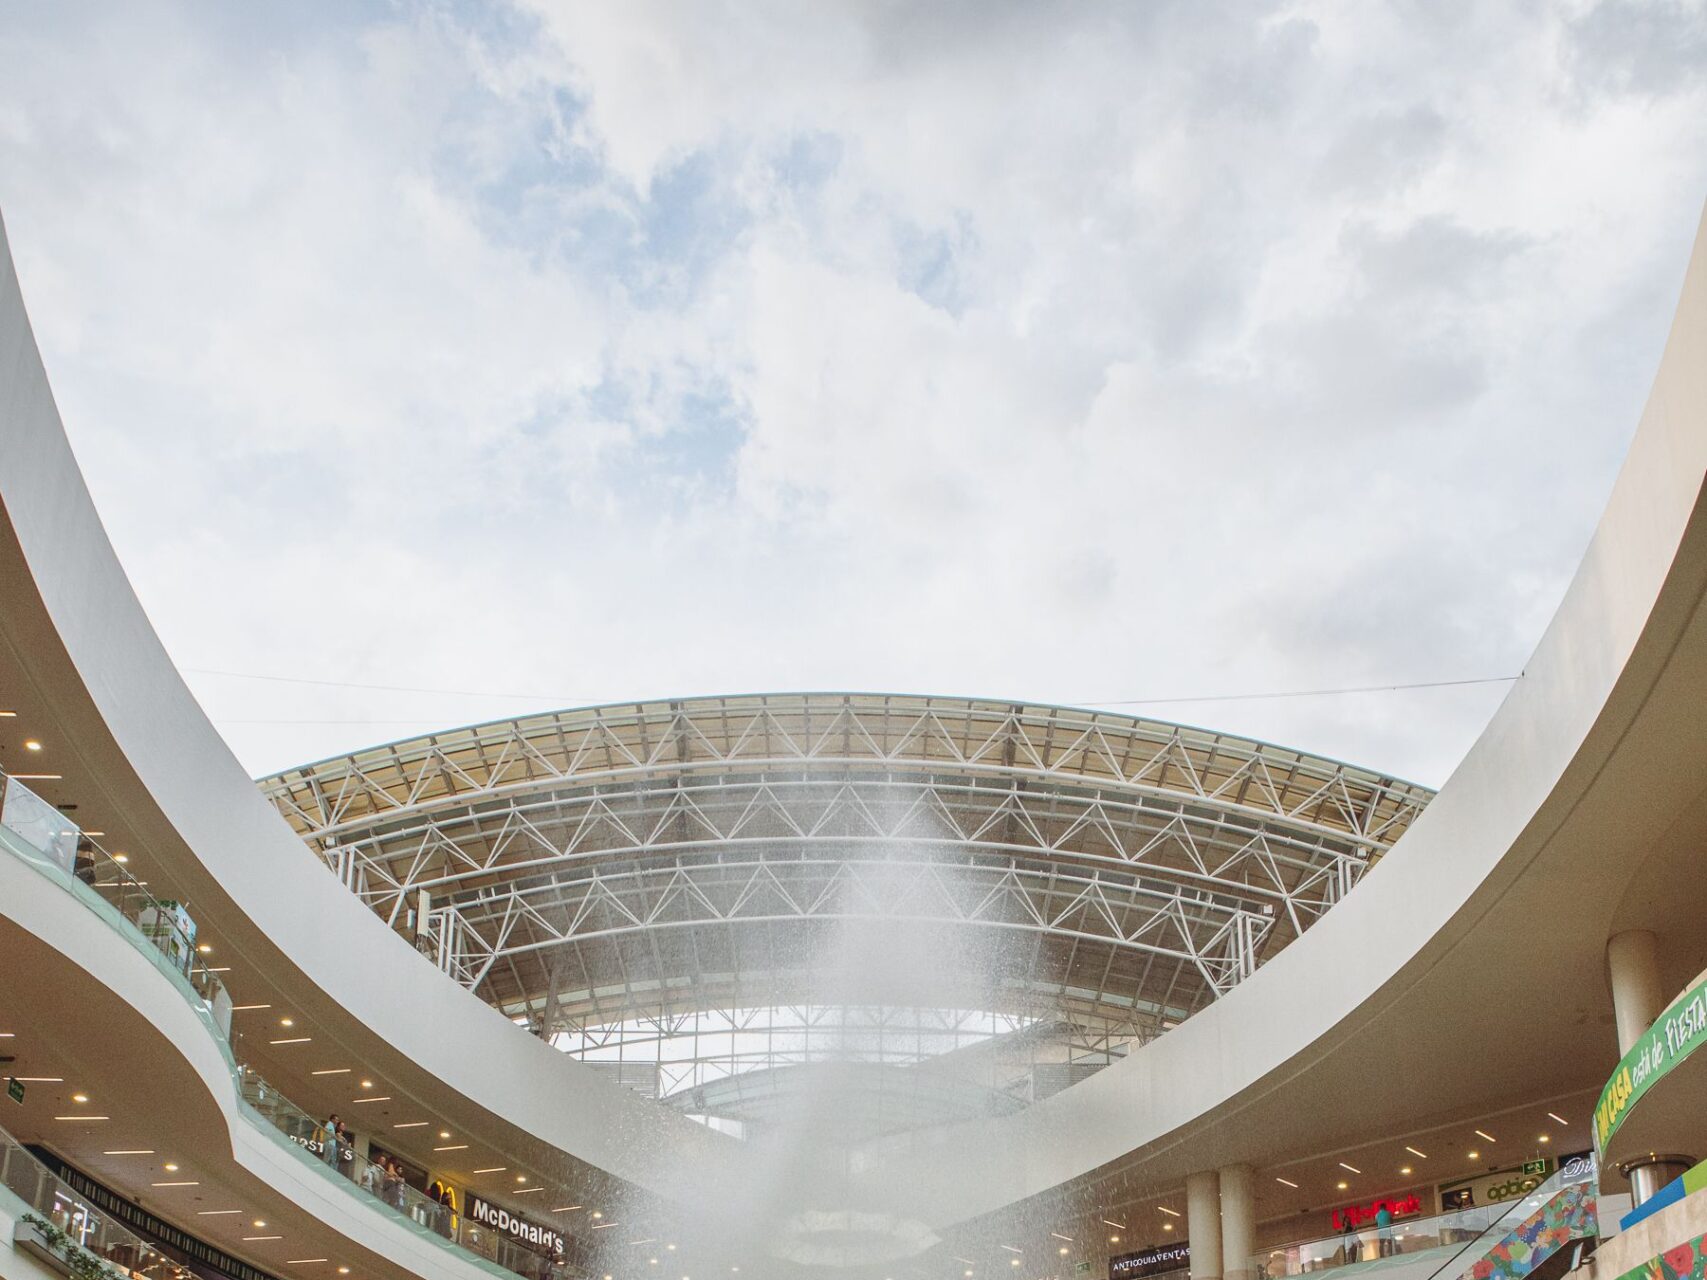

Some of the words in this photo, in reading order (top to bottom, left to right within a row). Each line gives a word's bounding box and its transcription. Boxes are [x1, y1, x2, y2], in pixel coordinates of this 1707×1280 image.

[1608, 1066, 1633, 1124] CASA
[1651, 1033, 1664, 1071] de
[473, 1199, 564, 1254] McDonald's
